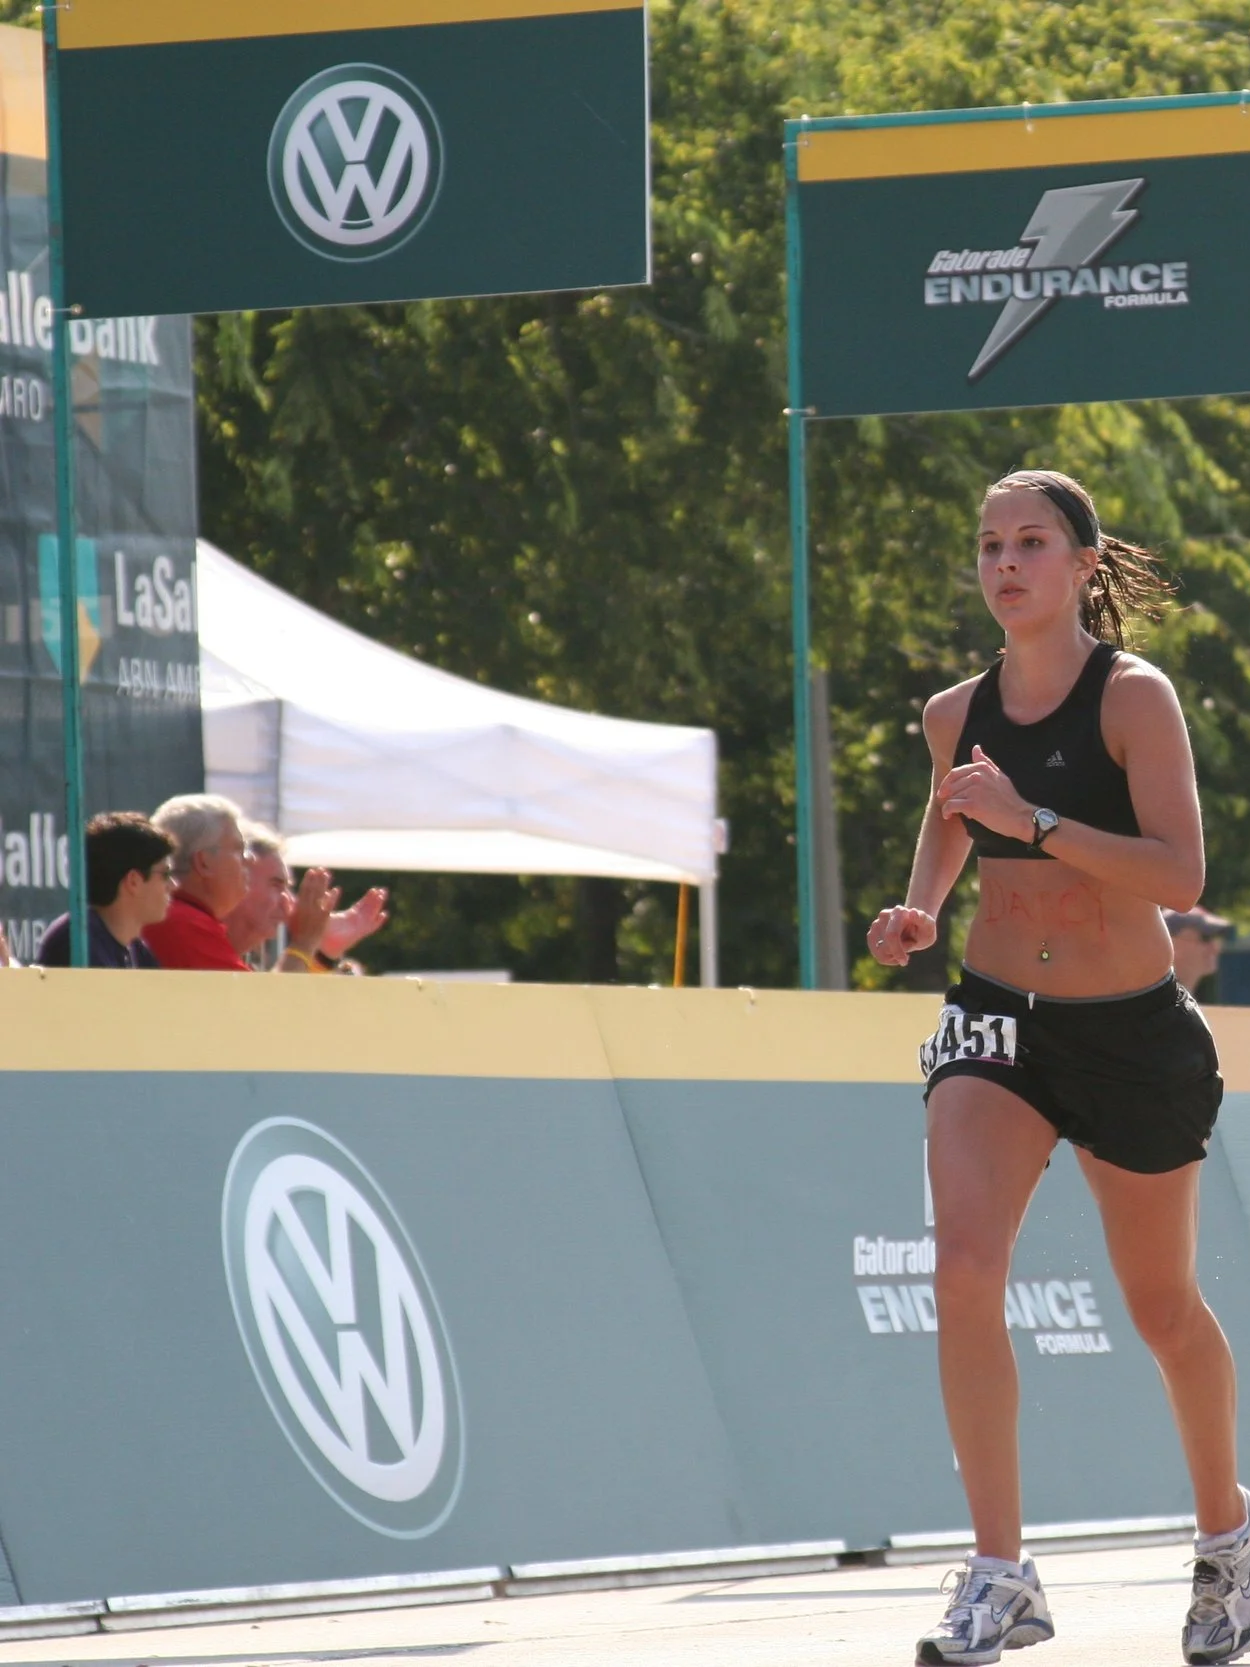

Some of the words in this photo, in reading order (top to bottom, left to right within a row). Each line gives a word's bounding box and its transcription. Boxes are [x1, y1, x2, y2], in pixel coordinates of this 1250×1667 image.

[927, 247, 1031, 273] Gatorade
[925, 262, 1189, 304] ENDURANCE
[1104, 291, 1189, 308] FORMULA
[1035, 1333, 1112, 1354] FORMULA
